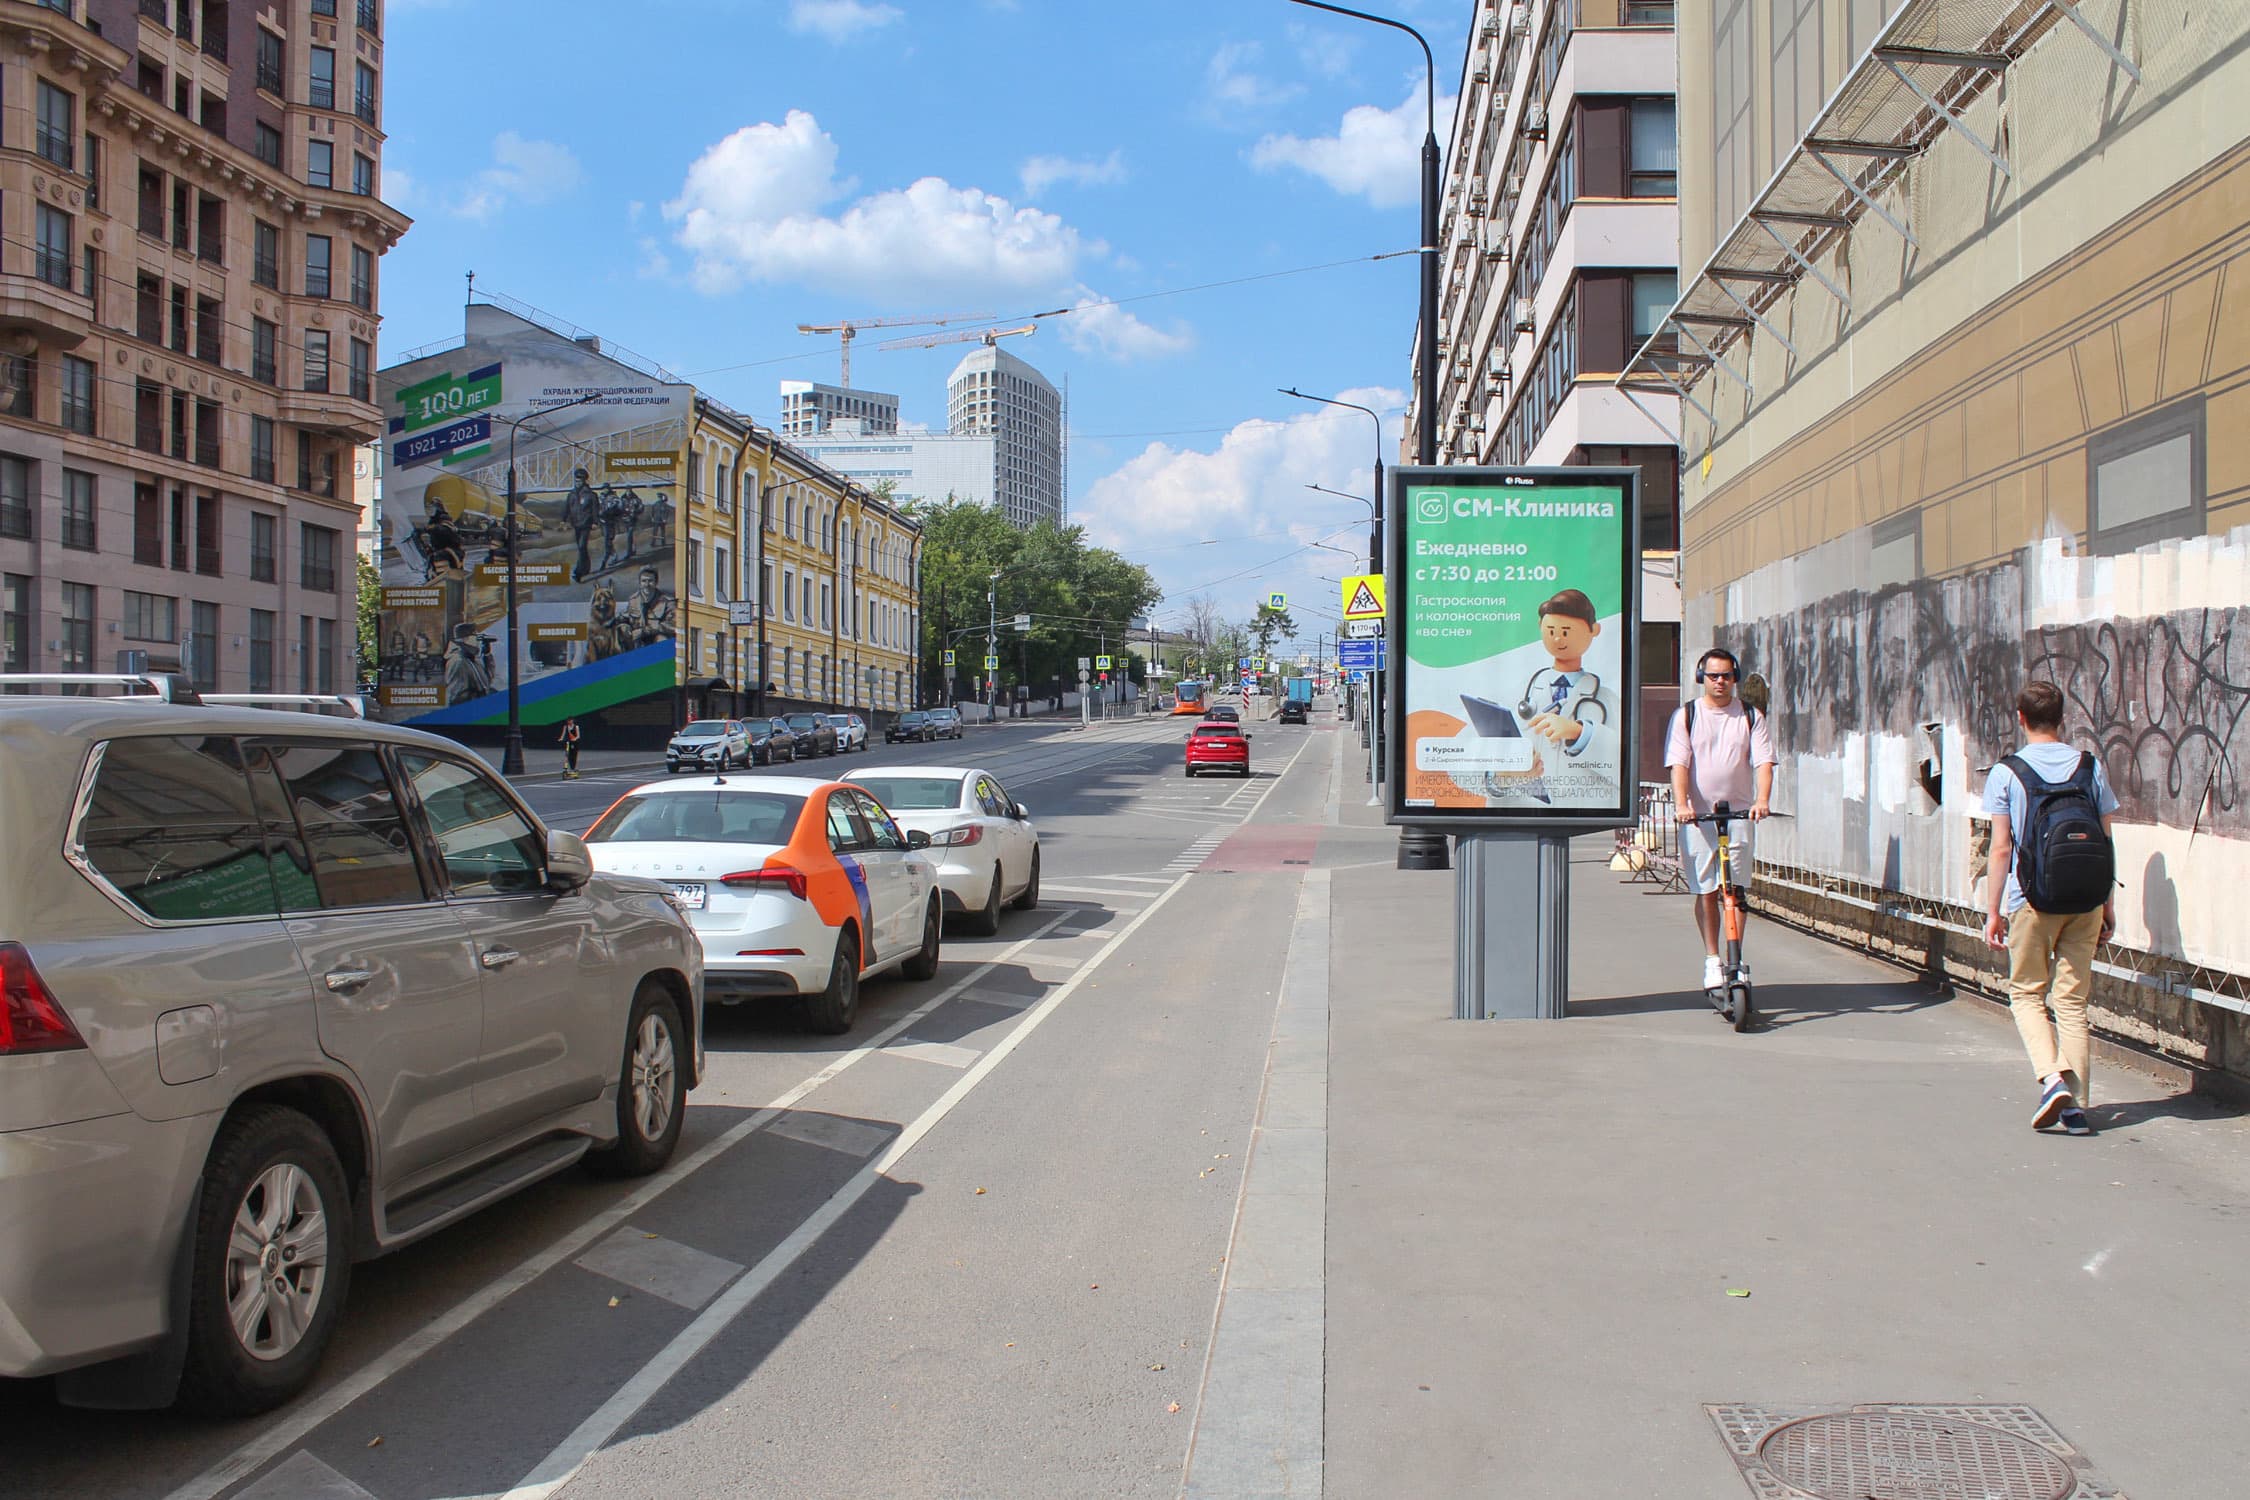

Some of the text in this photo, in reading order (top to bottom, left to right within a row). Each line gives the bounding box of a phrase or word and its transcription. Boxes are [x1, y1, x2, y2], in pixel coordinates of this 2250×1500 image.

[543, 387, 571, 395] ОХРАНА
[420, 387, 489, 420] 100 ЛЕТ
[529, 398, 573, 406] ТРАНСПОРТА
[624, 397, 670, 405] ФЕДЕРАЦИИ
[408, 437, 437, 457] 1921
[449, 424, 480, 443] 2021
[1514, 476, 1535, 485] Russ
[1453, 498, 1615, 517] СМ-Клиника
[1415, 540, 1528, 558] Ежедневно
[1415, 565, 1557, 583] с 7:30 до 21:00
[1415, 594, 1506, 609] Гастроскопия
[1415, 612, 1521, 622] и колоноскопия
[1357, 624, 1368, 632] 170
[1415, 628, 1472, 637] «во сне»
[1432, 746, 1465, 754] Курская
[1567, 761, 1613, 769] smclinic.ru
[1415, 775, 1458, 786] ИМЕЮТСЯ
[1552, 775, 1613, 786] НЕОБХОДИМО
[678, 885, 701, 897] 797
